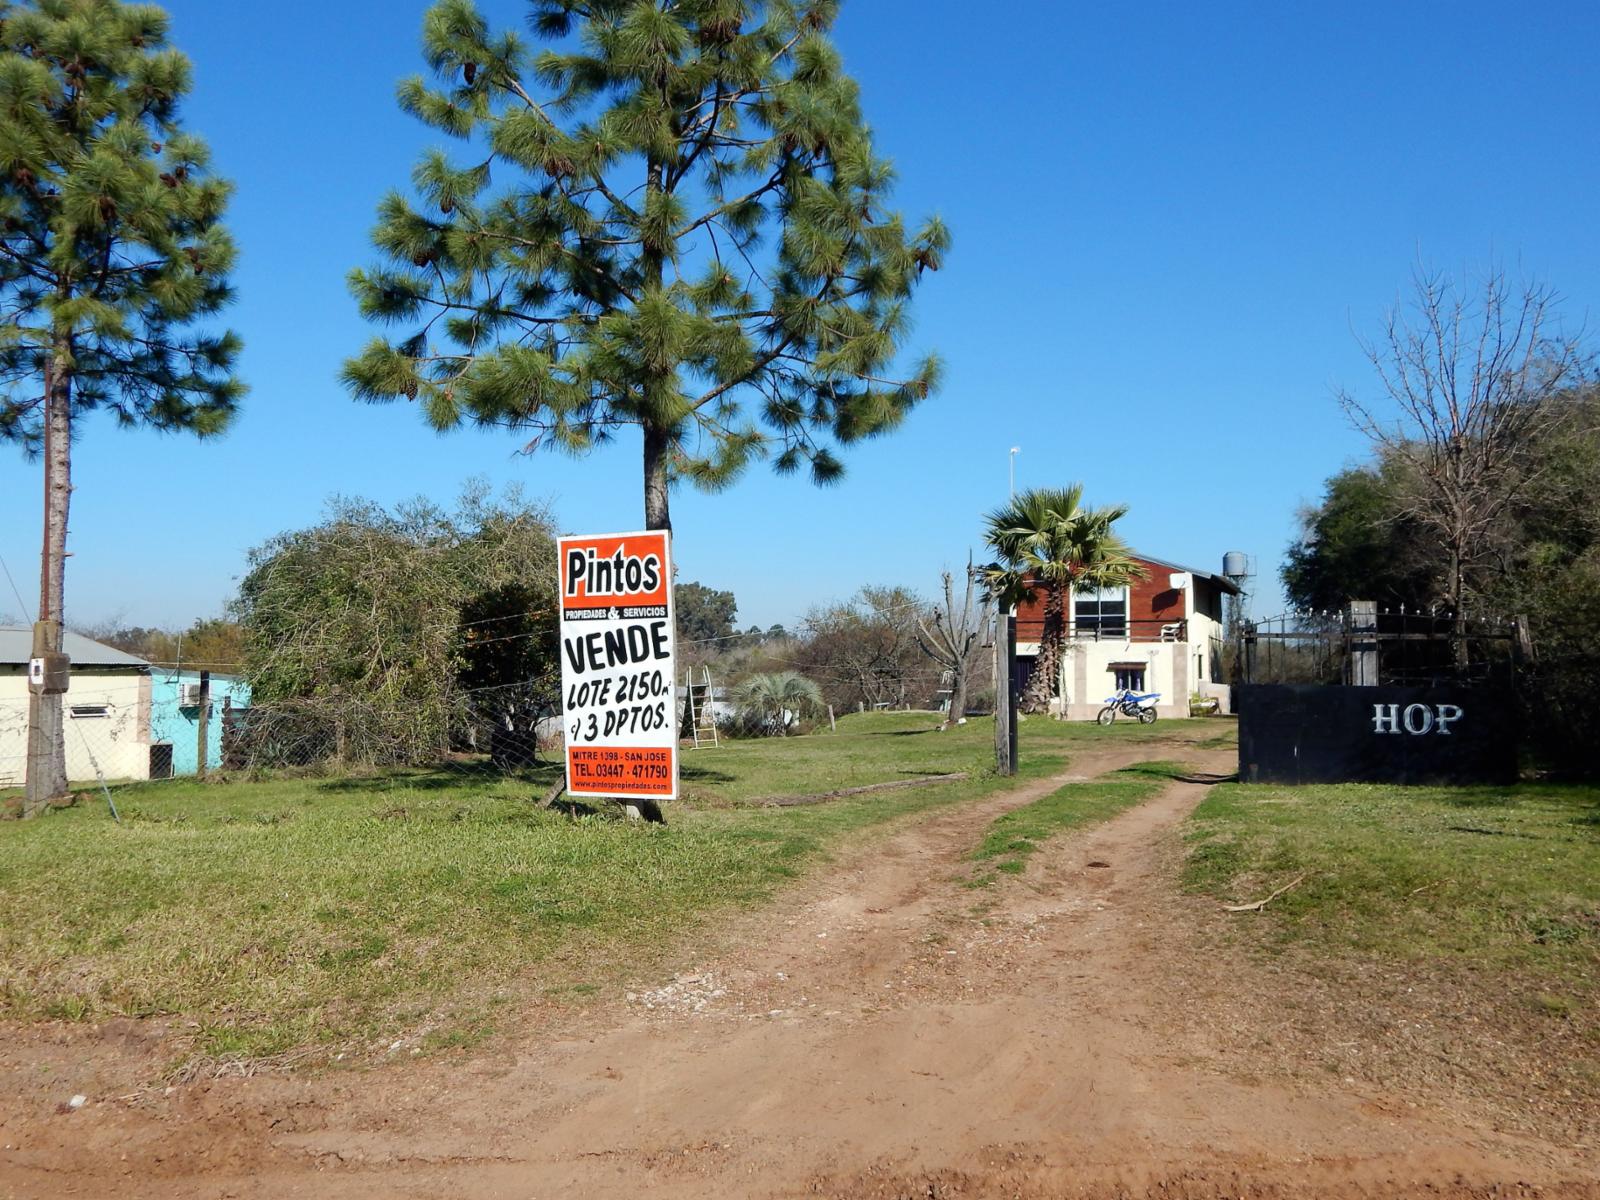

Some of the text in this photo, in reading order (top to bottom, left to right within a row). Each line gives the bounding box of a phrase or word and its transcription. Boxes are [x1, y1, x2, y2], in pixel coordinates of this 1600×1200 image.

[567, 548, 659, 594] Pintos
[566, 606, 665, 620] PROPIEDADES & SERVICIOS
[564, 621, 670, 674] VENDE
[567, 678, 612, 711] LOTE
[584, 713, 598, 742] 3
[603, 702, 669, 737] DPTOS.
[1371, 703, 1464, 735] HOP
[573, 752, 597, 760] MITRE
[625, 752, 642, 761] SAN
[644, 753, 666, 761] JOSE
[632, 765, 667, 778] 471790
